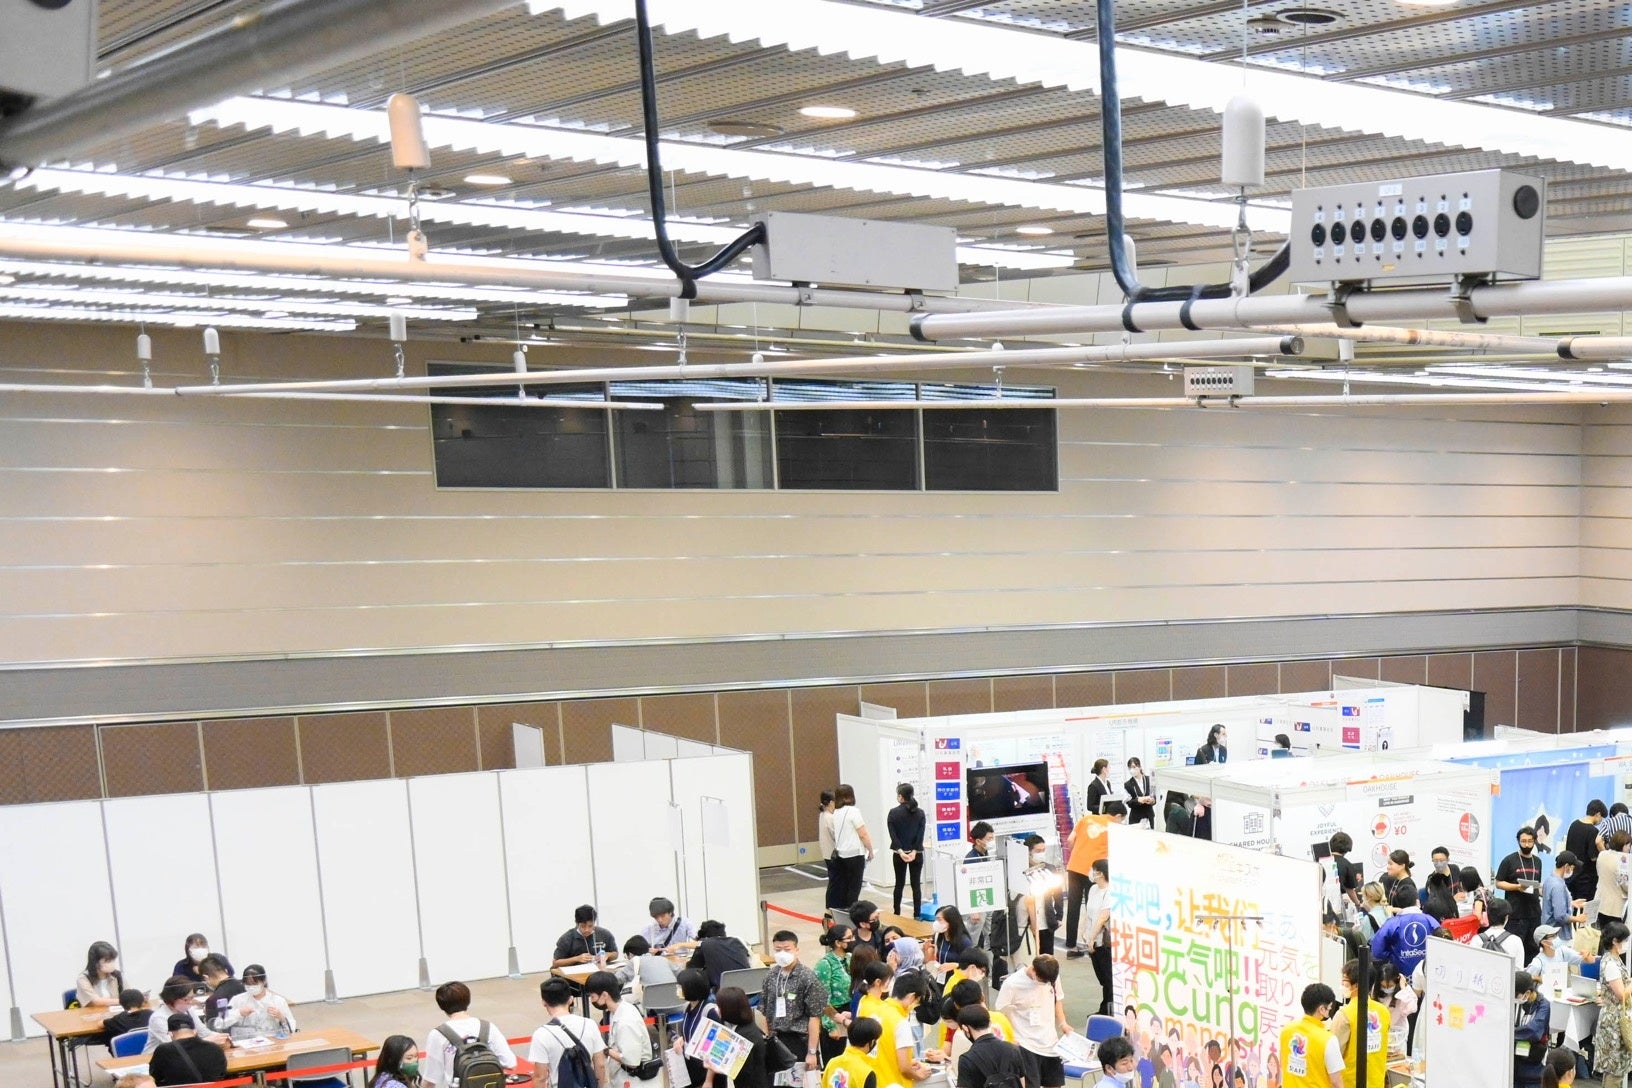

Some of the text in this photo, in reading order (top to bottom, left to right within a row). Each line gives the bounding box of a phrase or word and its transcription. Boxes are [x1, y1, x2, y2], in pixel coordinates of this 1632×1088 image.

[1362, 783, 1399, 793] OAKHOUSE
[1394, 825, 1407, 836] ¥0
[969, 875, 993, 886] 非常口
